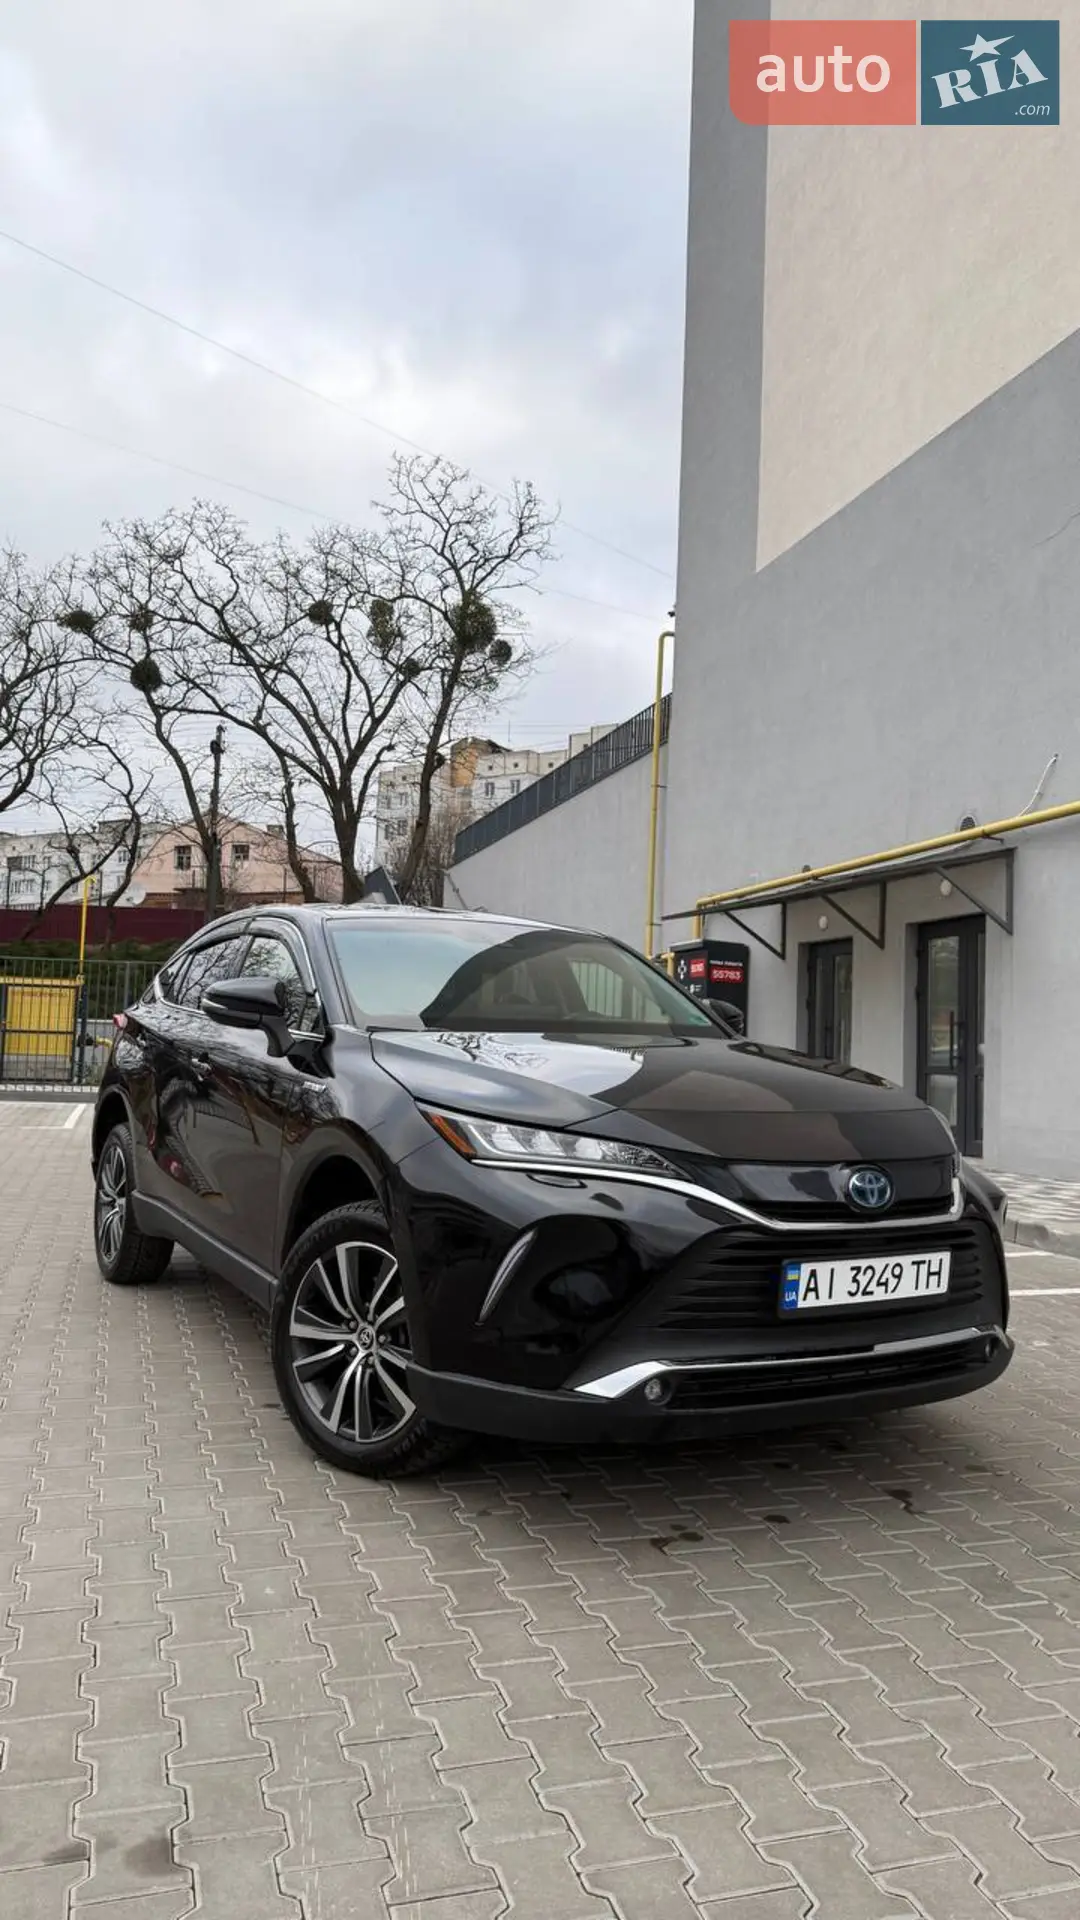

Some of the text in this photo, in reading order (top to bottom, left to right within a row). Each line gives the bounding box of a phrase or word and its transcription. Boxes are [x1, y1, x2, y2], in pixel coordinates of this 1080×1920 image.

[802, 1257, 943, 1302] AI 3249 TH
[784, 1291, 798, 1302] UA
